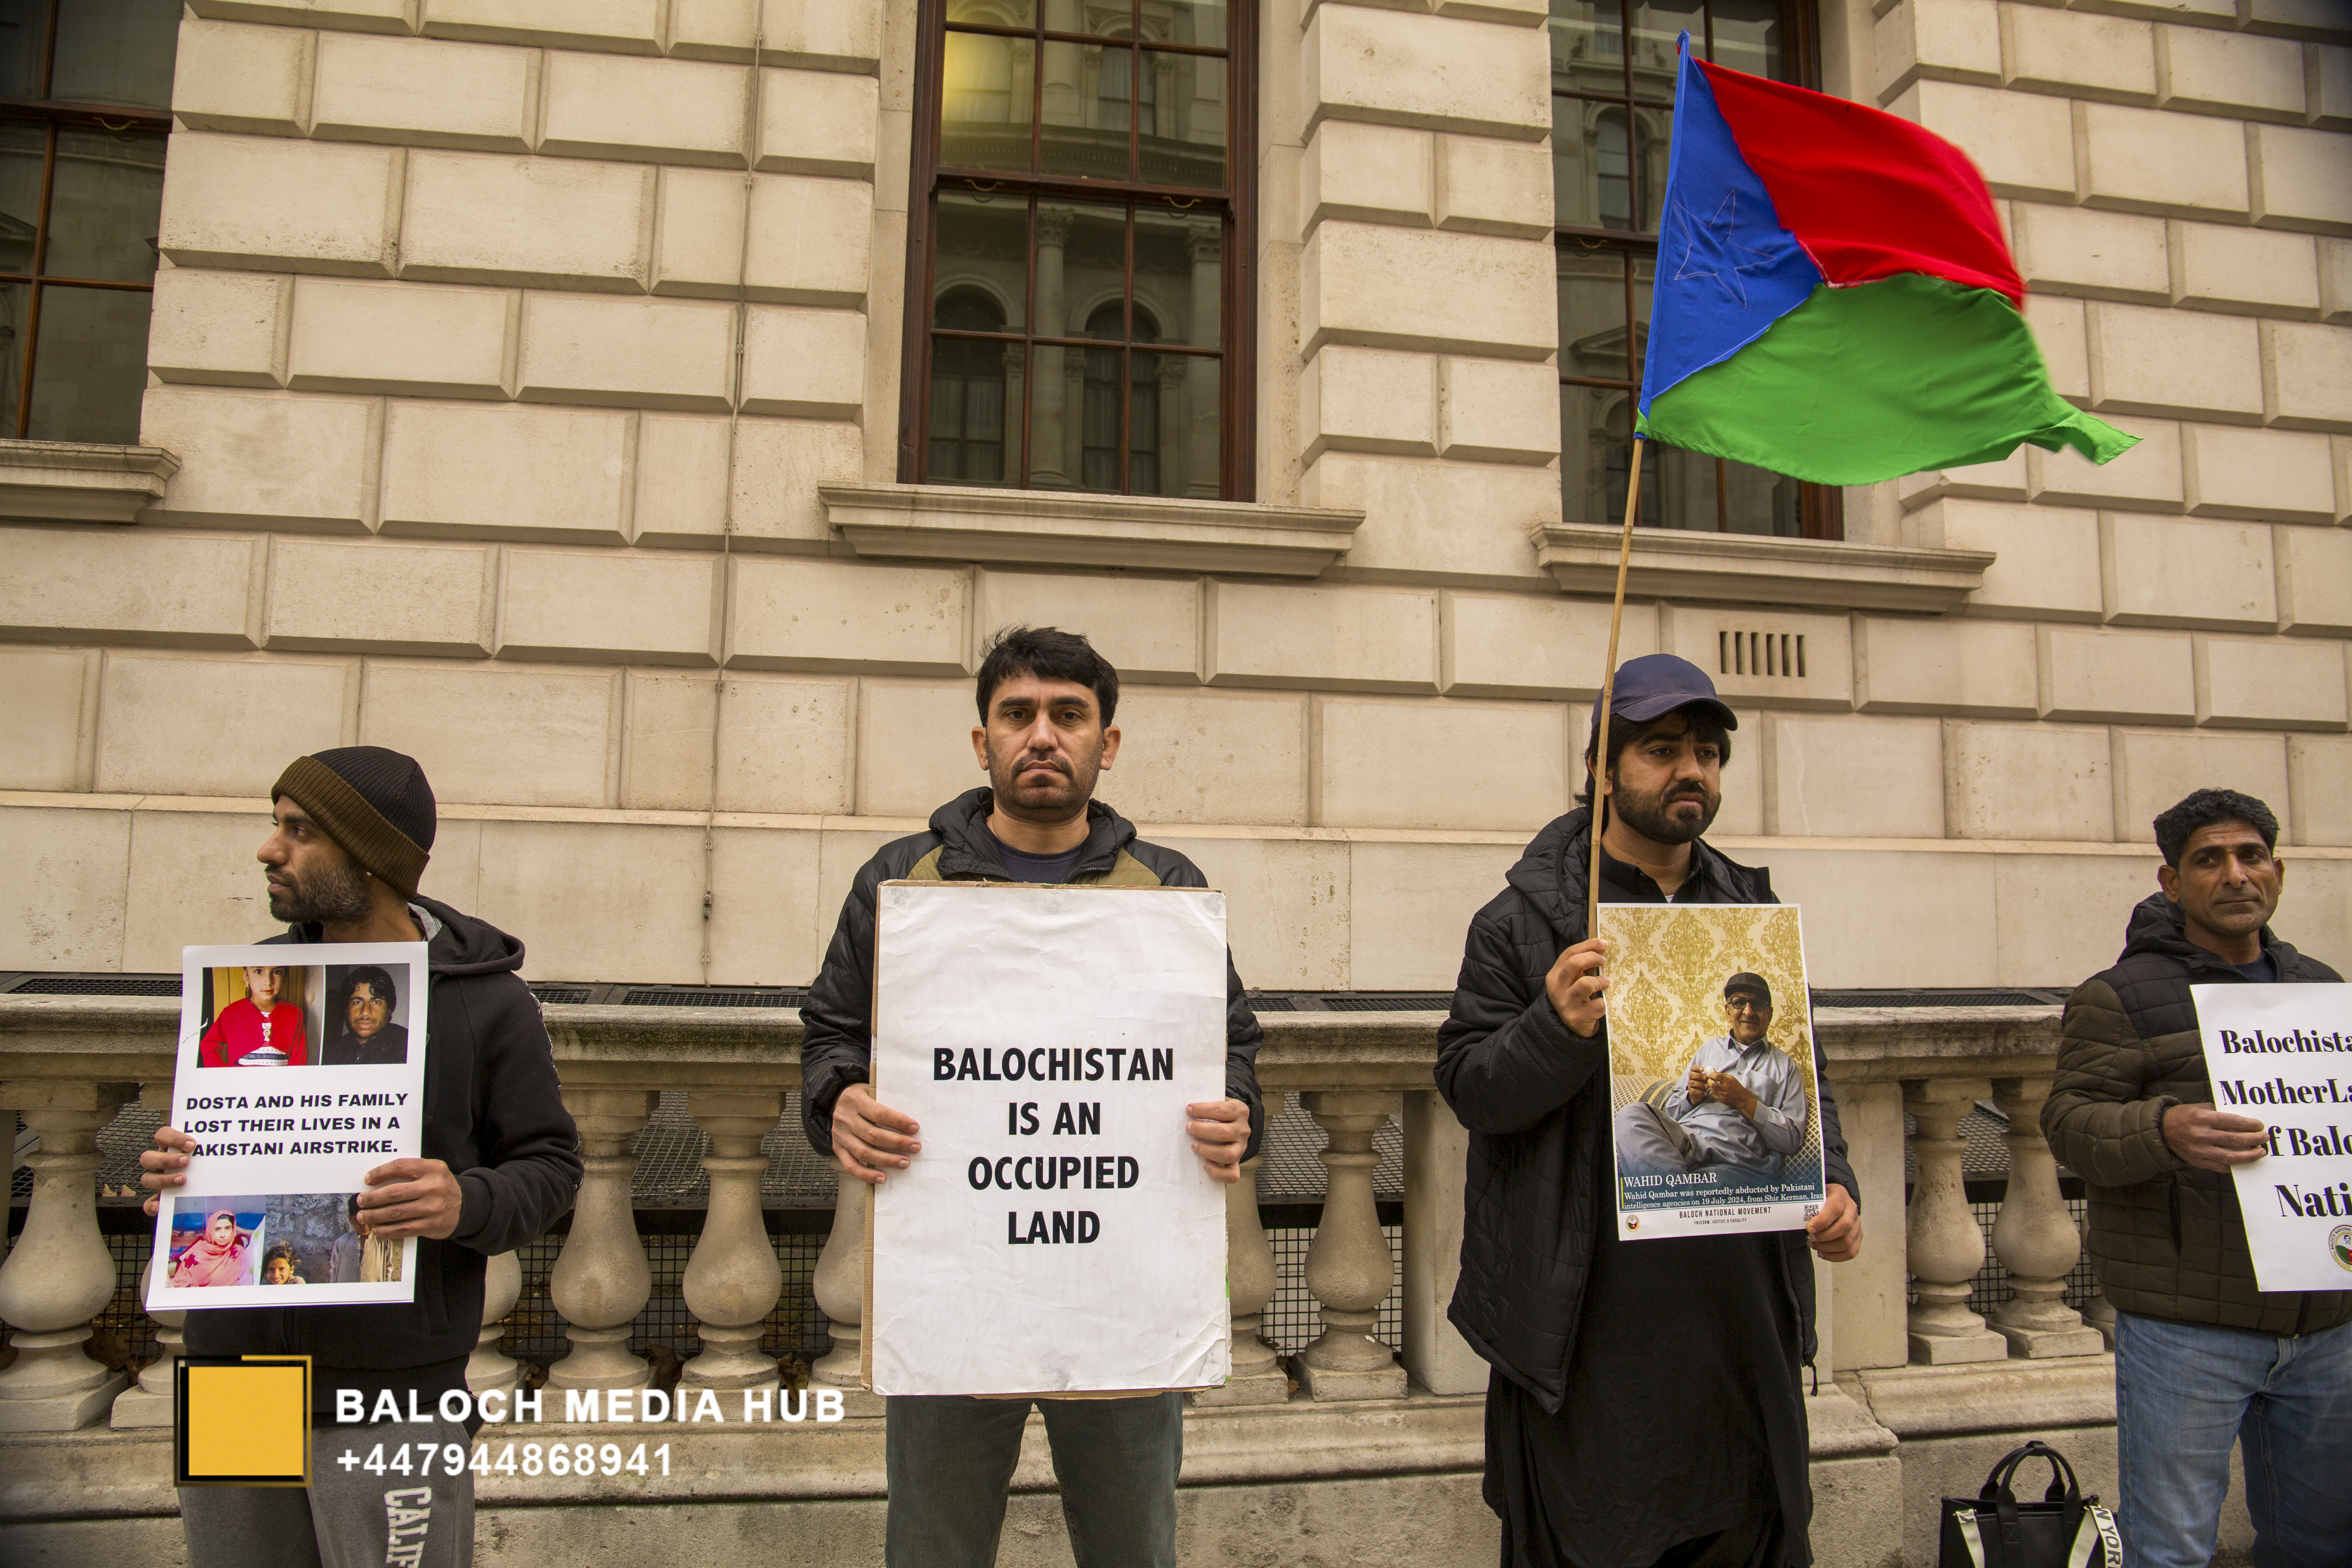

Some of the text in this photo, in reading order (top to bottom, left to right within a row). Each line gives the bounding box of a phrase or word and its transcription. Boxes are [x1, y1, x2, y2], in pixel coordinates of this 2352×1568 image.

[934, 1048, 1173, 1081] BALOCHISTAN
[2219, 1078, 2352, 1105] MotherL
[187, 1094, 408, 1109] DOSTA AND HIS FAMILY
[184, 1117, 400, 1133] LOST THEIR LIVES IN A
[1009, 1102, 1100, 1135] IS AN
[192, 1140, 397, 1156] AKISTANI AIRSTRIKE.
[968, 1156, 1139, 1190] OCCUPIED
[1624, 1173, 1717, 1187] WAHID QAMBAR
[1624, 1191, 1647, 1200] Wahid
[1649, 1190, 1678, 1200] Qambar
[1696, 1187, 1733, 1197] reportedly
[1735, 1185, 1768, 1194] abducted
[1770, 1185, 1779, 1194] by
[1781, 1183, 1815, 1192] Pakistani
[1624, 1201, 1661, 1209] intelligence
[1662, 1199, 1690, 1208] agencies
[1738, 1207, 1771, 1215] MOVEMENT
[1009, 1211, 1100, 1244] LAND
[2101, 1526, 2121, 1568] YOR
